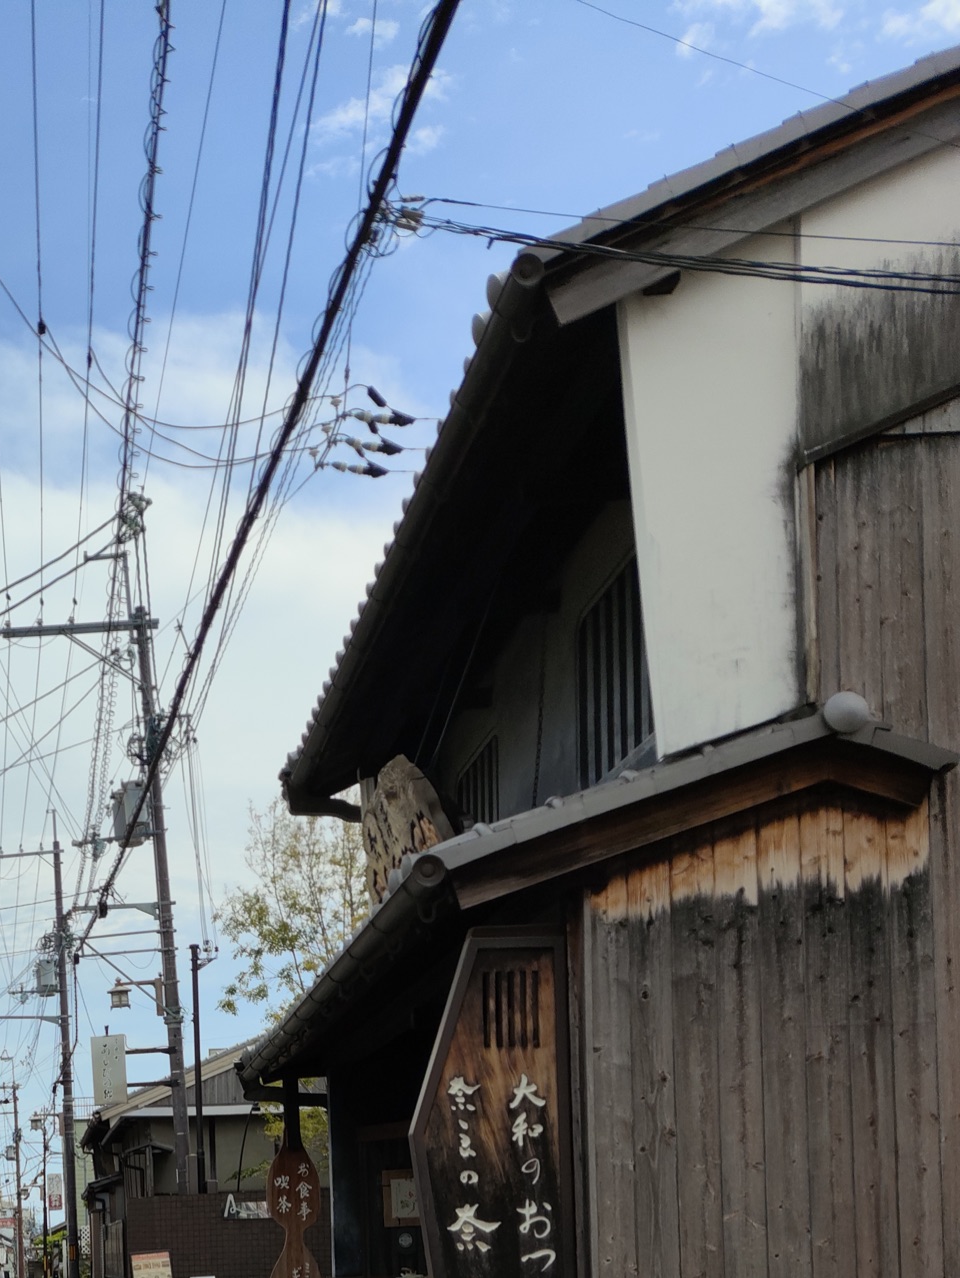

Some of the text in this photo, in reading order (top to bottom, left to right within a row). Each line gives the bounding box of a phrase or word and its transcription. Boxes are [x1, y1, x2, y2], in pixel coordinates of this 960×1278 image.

[273, 1174, 292, 1214] 喫茶
[295, 1162, 313, 1221] お食事
